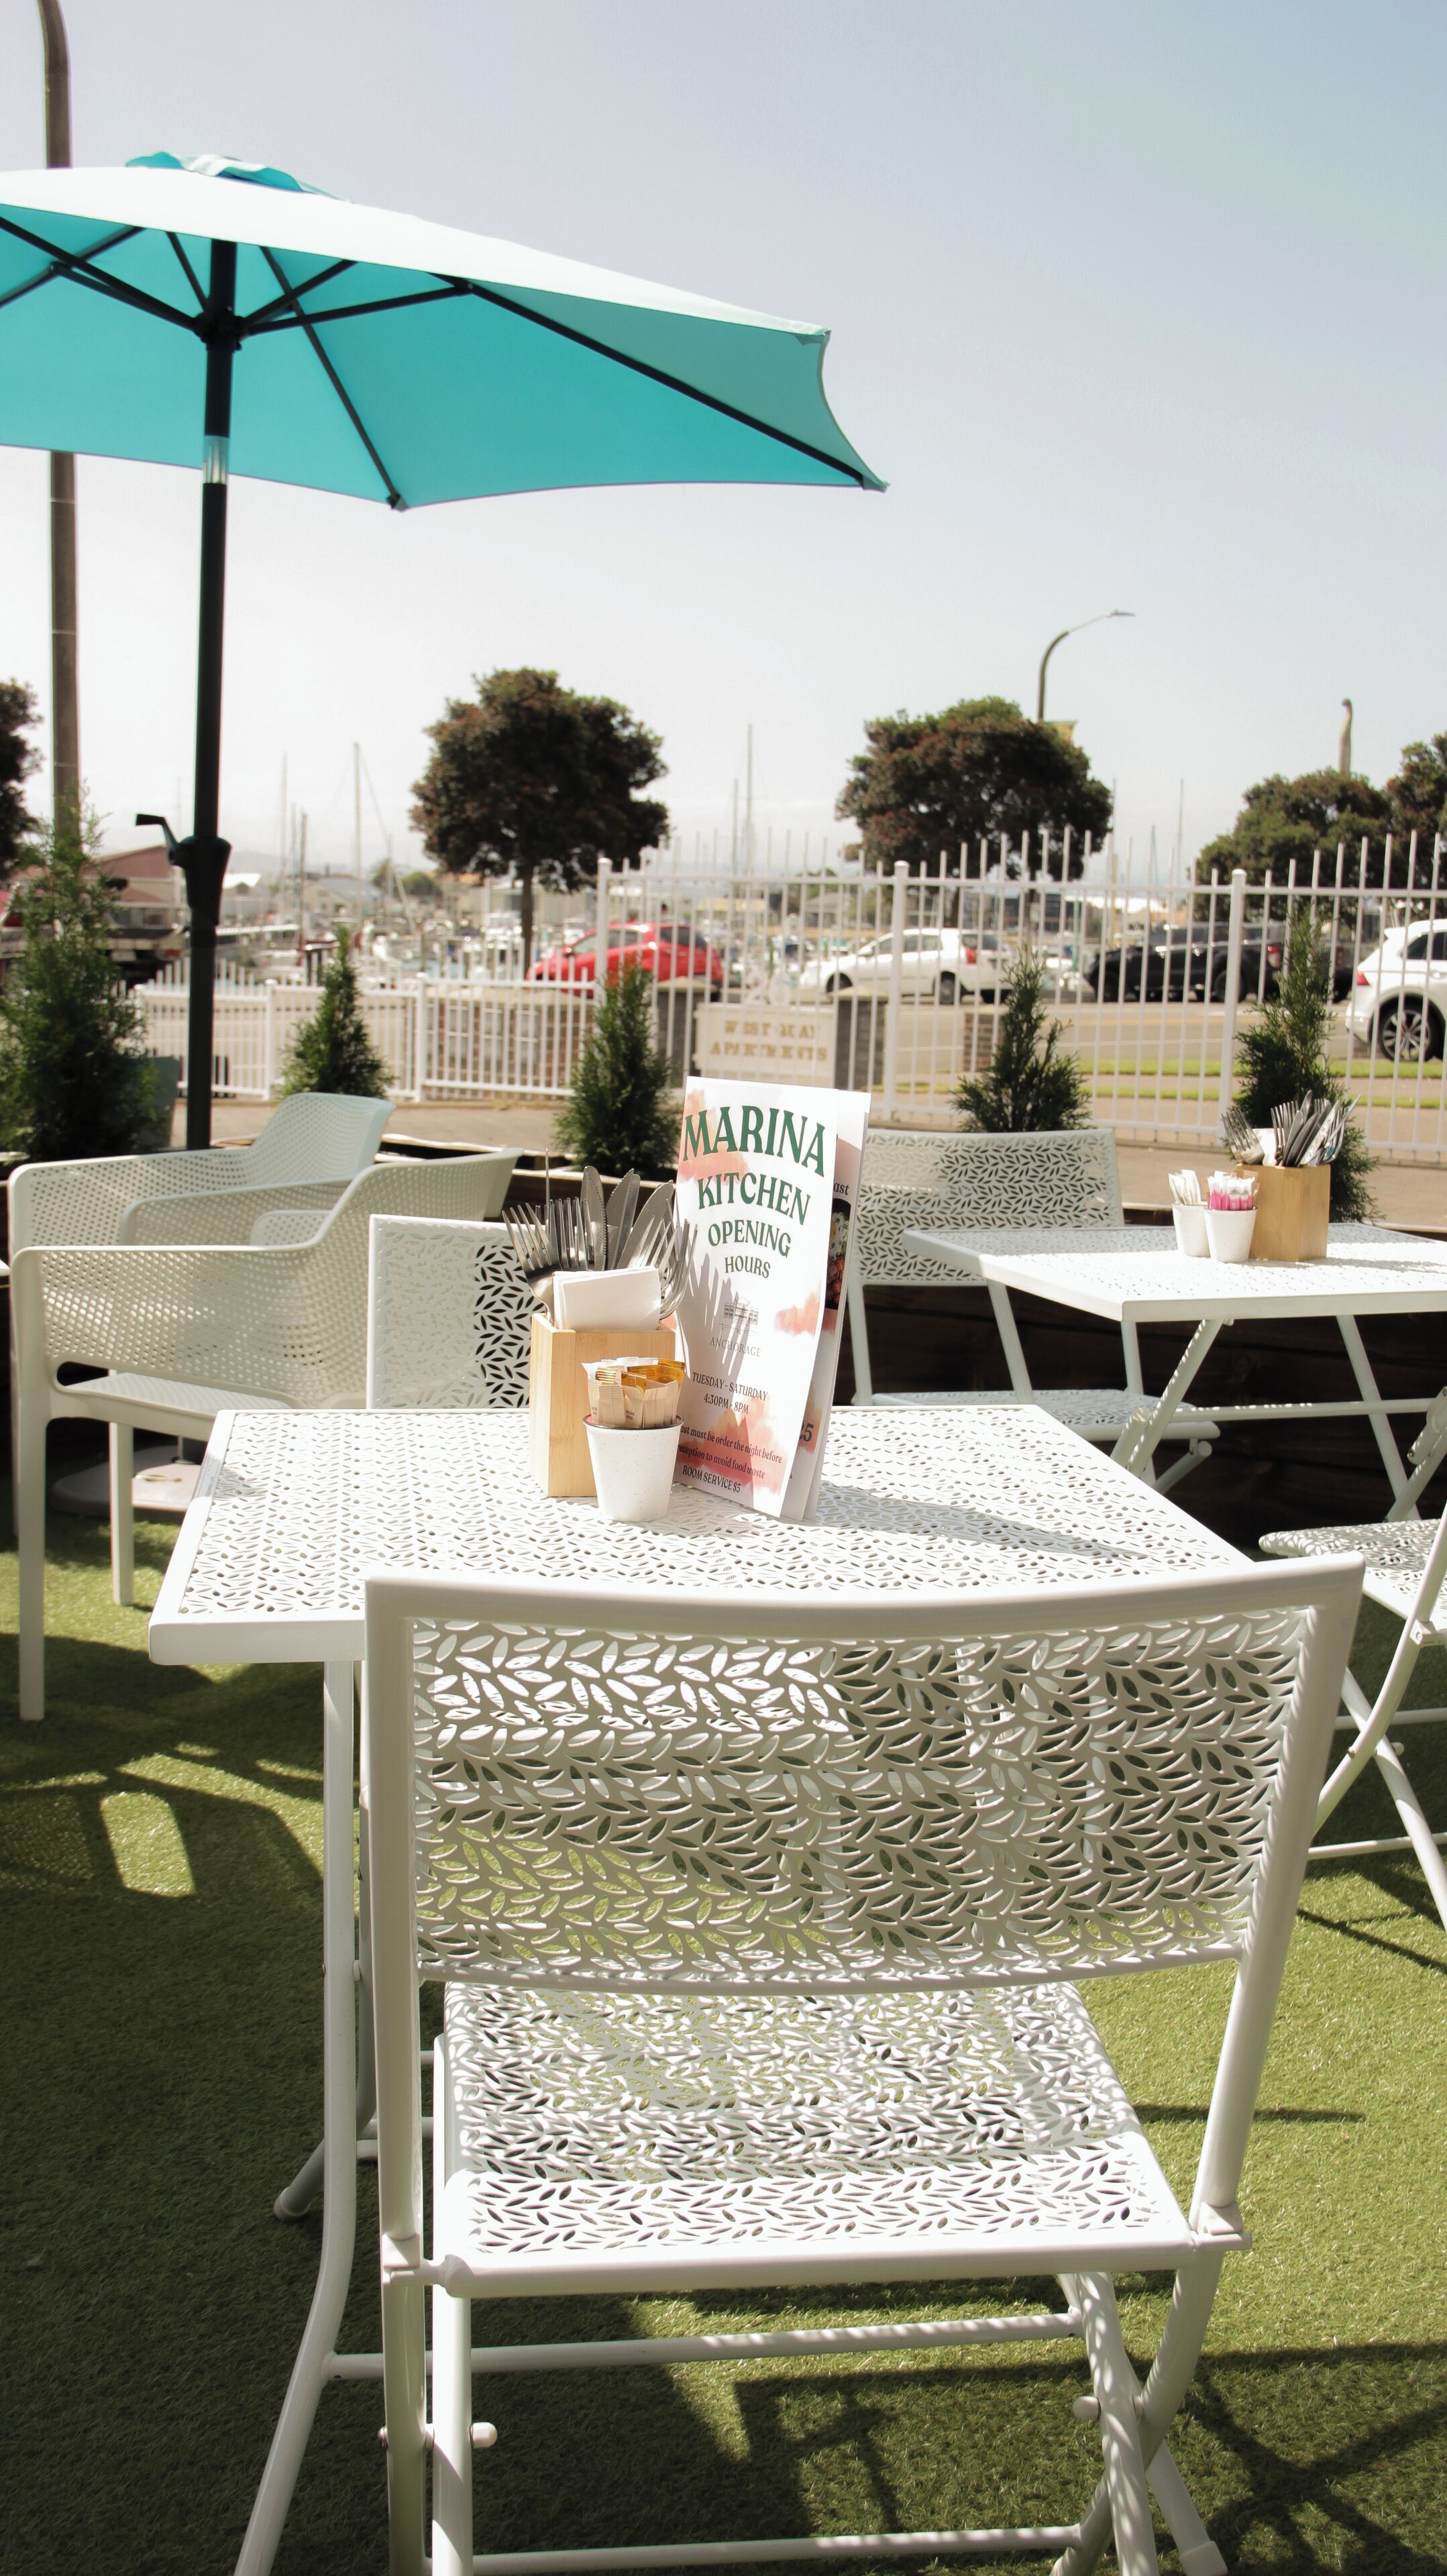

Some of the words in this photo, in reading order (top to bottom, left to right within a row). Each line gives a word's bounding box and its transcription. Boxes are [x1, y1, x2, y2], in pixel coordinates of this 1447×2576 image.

[683, 1106, 825, 1177] MARINA
[698, 1172, 811, 1225] KITCHEN
[833, 1182, 849, 1195] ast
[708, 1220, 791, 1258] OPENING
[725, 1255, 770, 1279] HOURS
[709, 1337, 761, 1356] ANCHORAGE
[692, 1372, 725, 1389] TUESDAY
[729, 1382, 768, 1401] SATURDAY
[704, 1393, 729, 1409] 4:30PM
[733, 1401, 749, 1414] 8PM
[690, 1429, 706, 1439] must
[707, 1431, 715, 1442] be
[716, 1436, 733, 1448] order
[734, 1440, 745, 1451] the
[745, 1444, 761, 1457] night
[762, 1448, 782, 1464] before
[682, 1465, 702, 1481] ROOM
[702, 1471, 733, 1490] SERVICE
[733, 1481, 741, 1493] $5
[706, 1451, 712, 1462] to
[713, 1456, 731, 1468] avoid
[732, 1459, 749, 1472] food
[747, 1466, 765, 1479] waste
